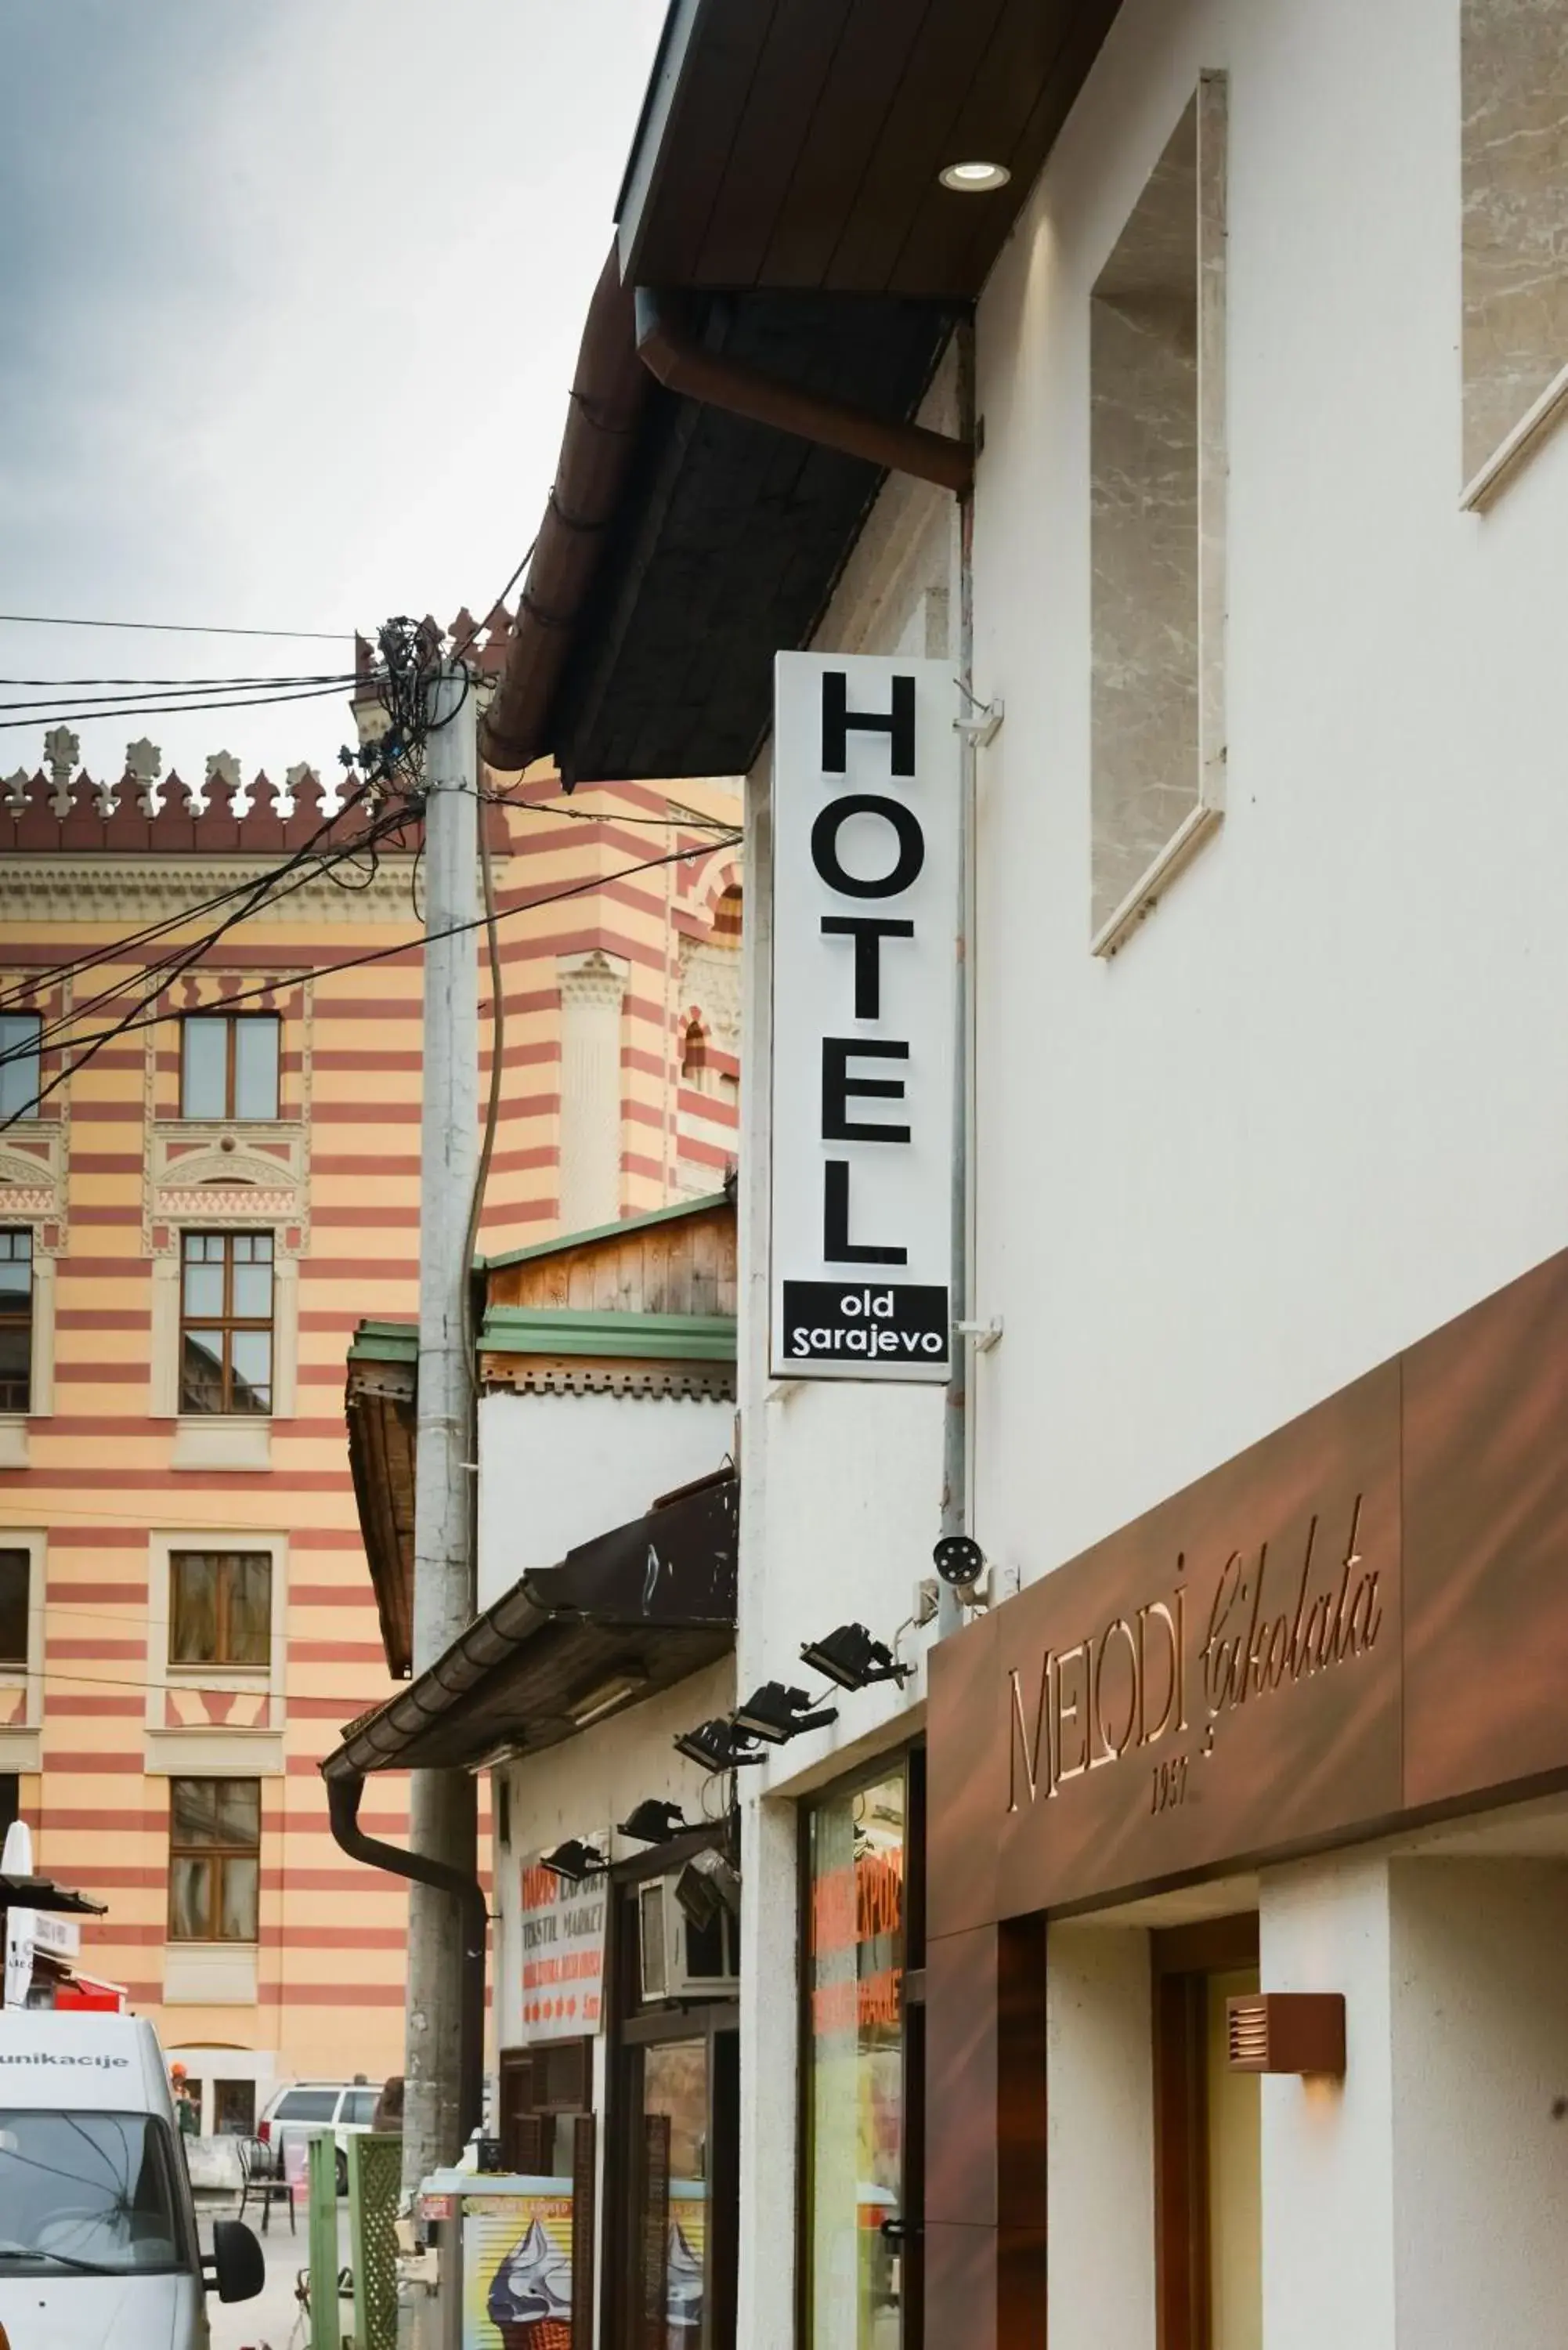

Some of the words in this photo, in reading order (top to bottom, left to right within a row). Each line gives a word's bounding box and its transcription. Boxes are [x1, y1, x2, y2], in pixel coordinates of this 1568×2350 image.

[811, 671, 925, 1266] HOTEL
[840, 1289, 894, 1318] old
[791, 1323, 944, 1358] sarajevo
[1151, 1755, 1189, 1815] 1957
[564, 1903, 605, 1938] MARKET
[0, 2052, 129, 2070] unikacije
